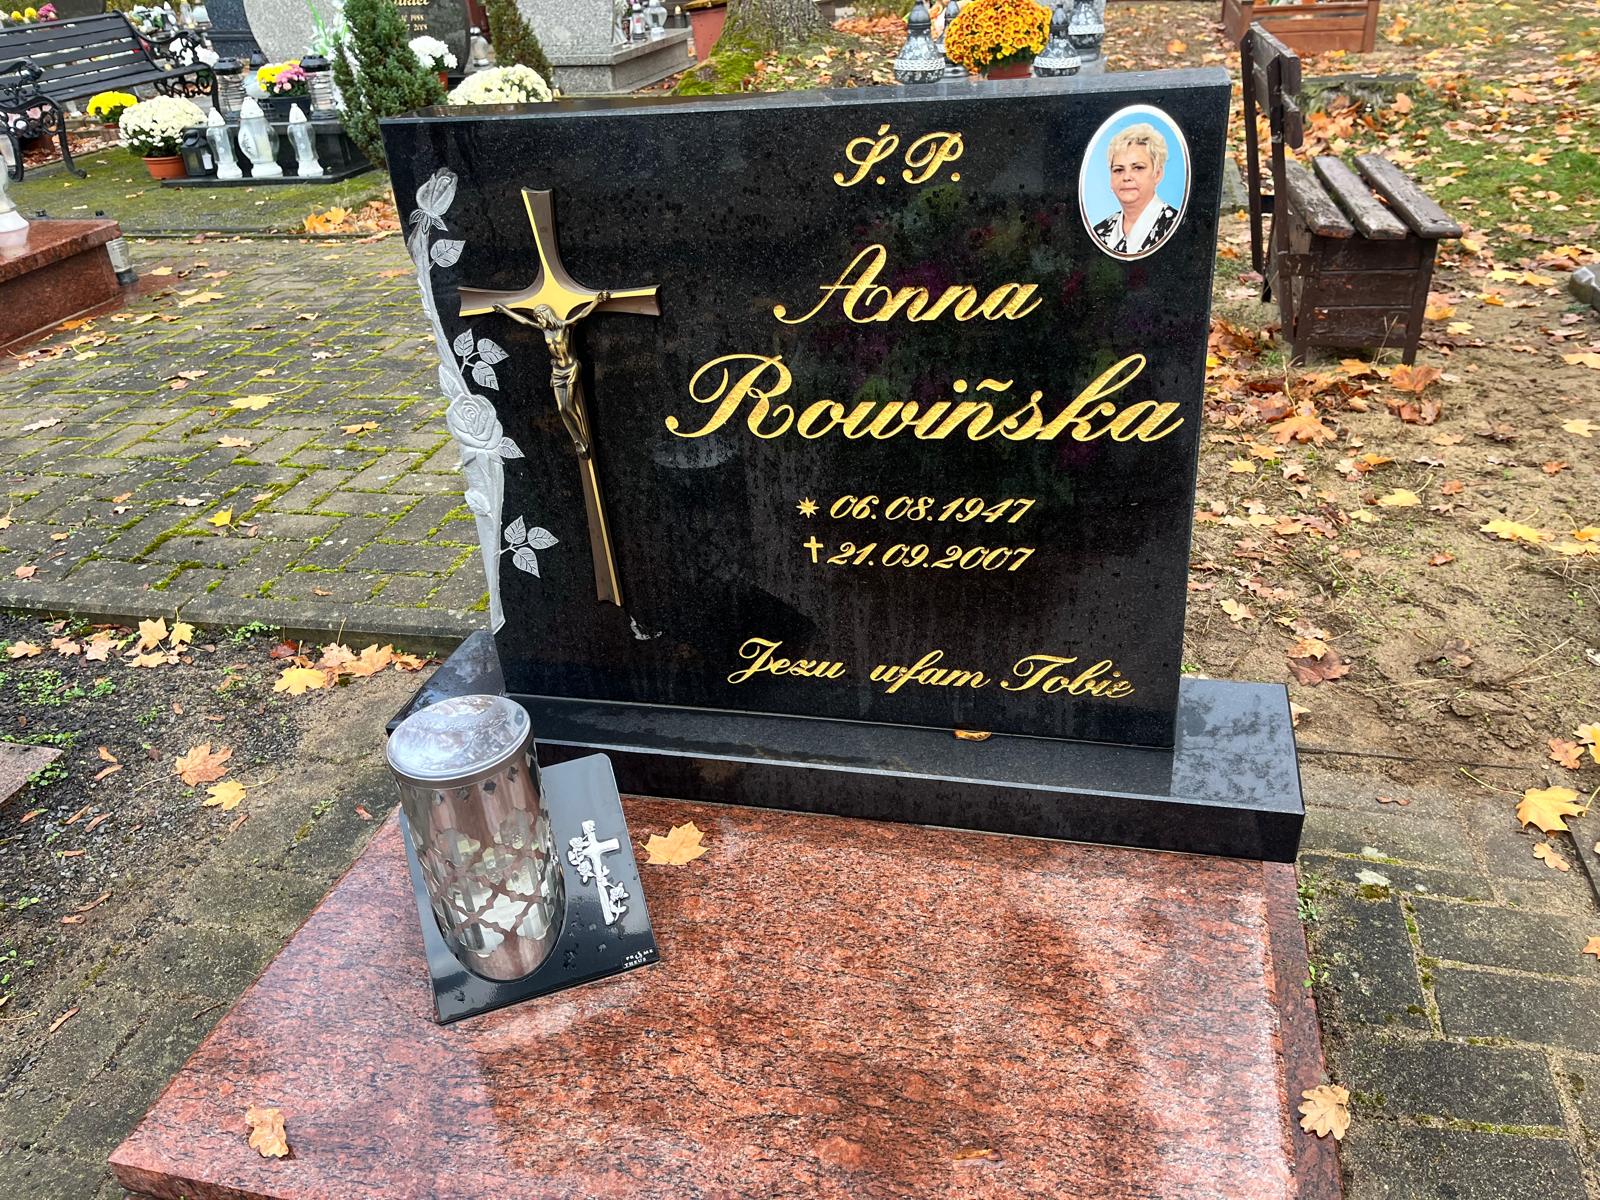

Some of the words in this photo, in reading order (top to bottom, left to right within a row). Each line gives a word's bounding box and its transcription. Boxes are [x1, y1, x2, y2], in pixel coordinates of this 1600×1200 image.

[773, 243, 1042, 325] Anna
[830, 495, 1036, 523] 06.08.1947
[827, 543, 1036, 571] 21.09.2007
[727, 637, 845, 685] Jezu
[869, 649, 990, 694] ufam
[1000, 654, 1135, 698] Tobie
